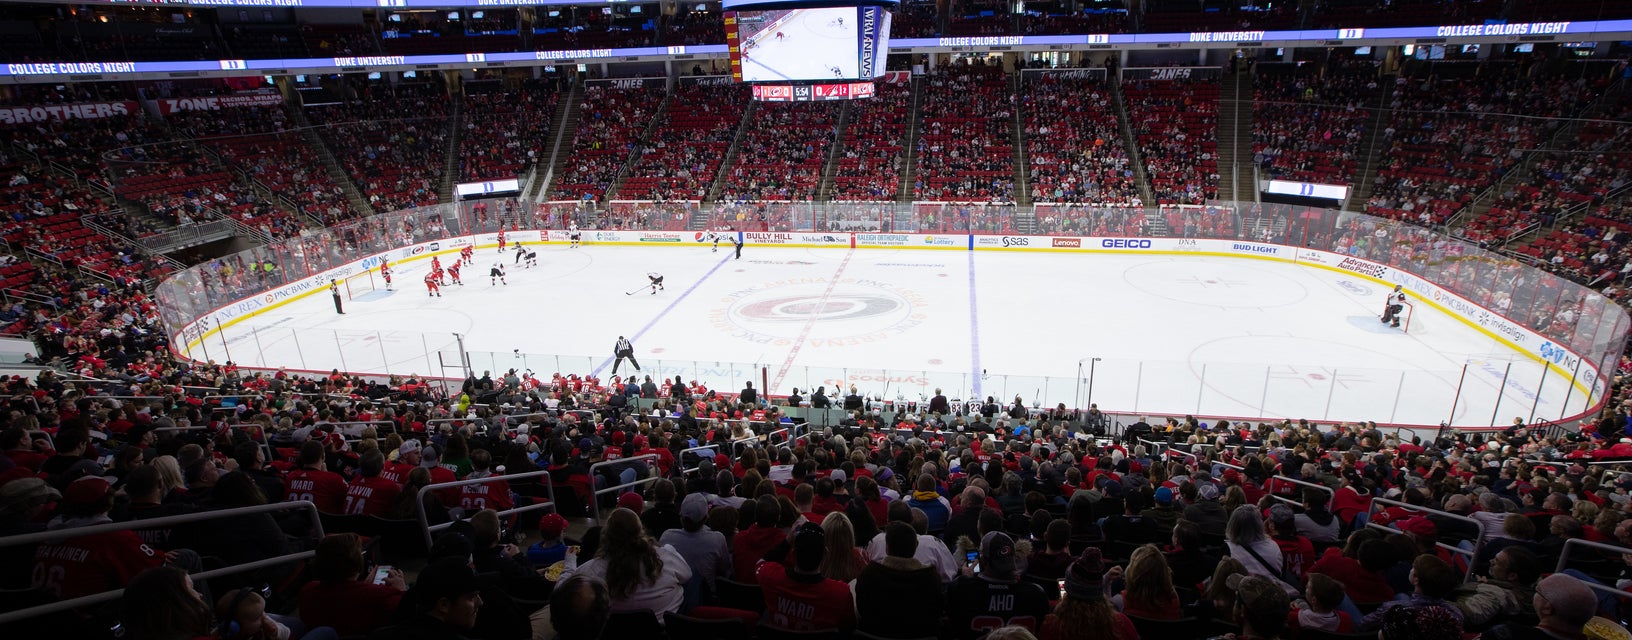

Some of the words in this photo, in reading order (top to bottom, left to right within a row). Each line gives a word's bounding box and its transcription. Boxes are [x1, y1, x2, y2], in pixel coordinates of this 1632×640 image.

[1437, 25, 1483, 36] COLLEGE
[1484, 23, 1528, 35] COLORS
[1529, 22, 1570, 33] NIGHT
[939, 37, 969, 46] COLLEGE
[970, 36, 998, 46] COLORS
[1000, 36, 1023, 45] NIGHT
[1190, 32, 1212, 41] DUKE
[1212, 31, 1265, 41] UNIVERSITY
[536, 51, 564, 60] COLLEGE
[565, 50, 590, 58] COLORS
[592, 49, 612, 57] NIGHT
[863, 41, 872, 77] NEWS
[334, 57, 356, 67] DUKE
[357, 56, 405, 66] UNIVERSITY
[8, 63, 57, 75] COLLEGE
[60, 62, 102, 74] COLORS
[104, 62, 136, 73] NIGHT
[1150, 68, 1192, 80] CANES
[611, 79, 643, 89] CANES
[795, 87, 809, 97] 5:54
[166, 98, 221, 113] ZONE
[0, 102, 129, 125] BROTHERS
[774, 233, 793, 241] HILL
[801, 235, 824, 243] Michael
[1102, 239, 1151, 249] GEICO
[1233, 243, 1251, 252] BUD
[1252, 245, 1278, 254] LIGHT
[378, 253, 389, 264] NC
[1342, 257, 1376, 270] Advance
[1337, 262, 1354, 271] Auto
[1354, 266, 1373, 276] Parts
[1392, 271, 1414, 285] UNC
[1414, 279, 1434, 297] REX
[273, 281, 313, 301] PNCBANK
[238, 297, 264, 314] REX
[1490, 317, 1526, 342] invisalign
[1563, 355, 1577, 372] NC
[951, 403, 961, 413] 83
[970, 403, 981, 413] 23
[291, 479, 314, 491] WARD
[777, 596, 815, 621] WARD
[988, 593, 1015, 612] AHO
